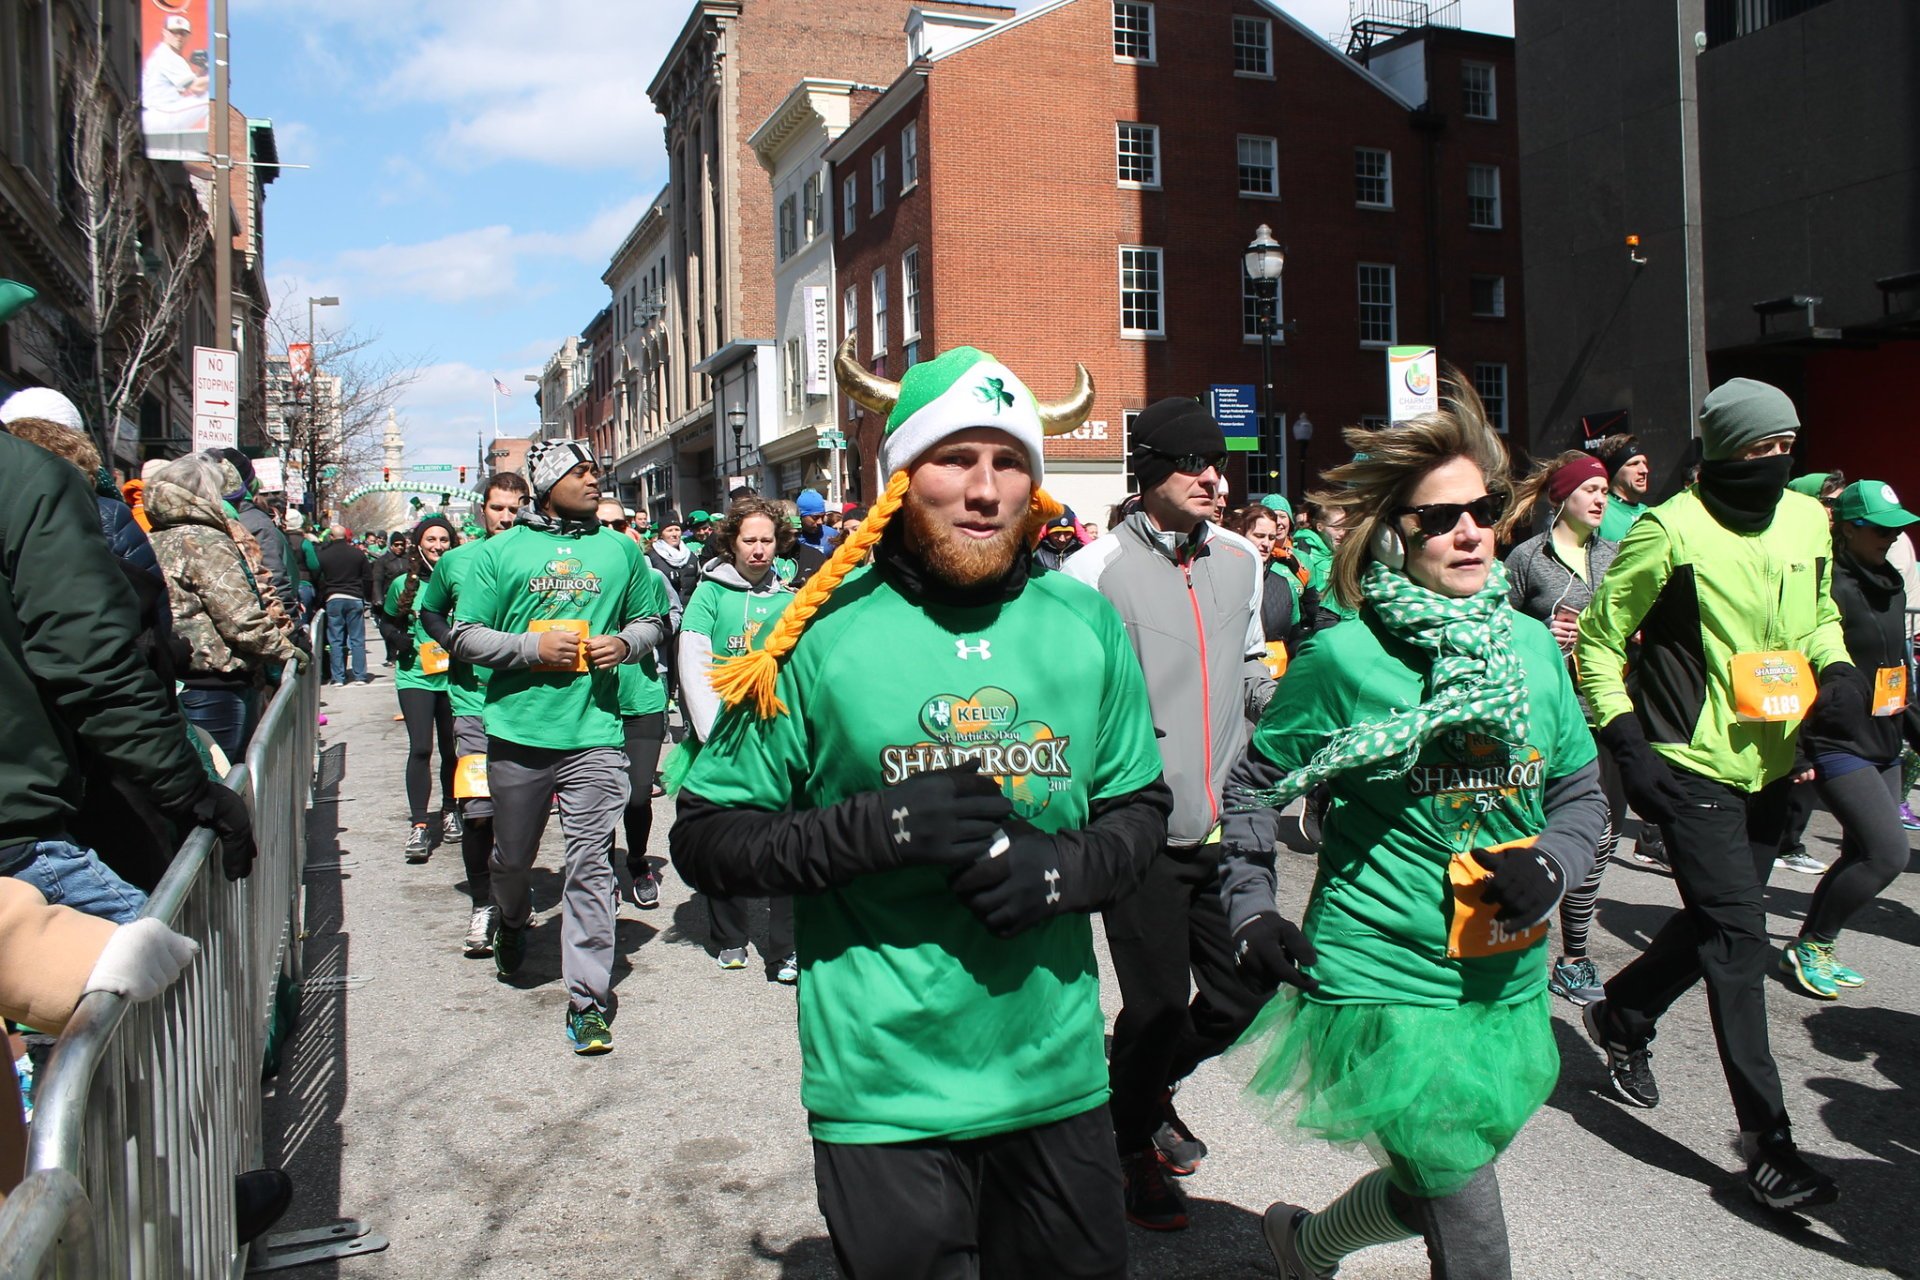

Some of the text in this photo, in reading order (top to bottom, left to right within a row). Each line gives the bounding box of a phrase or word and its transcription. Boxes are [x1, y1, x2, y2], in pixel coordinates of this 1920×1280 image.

[815, 298, 827, 381] BYTE RIGHT
[208, 357, 223, 371] NO
[198, 377, 234, 392] STOPPING
[208, 419, 222, 430] NO
[197, 430, 233, 443] PARKING
[530, 578, 601, 592] SHAMROCK
[556, 591, 571, 601] 5K
[1762, 694, 1799, 715] 4189
[957, 706, 1009, 722] KELLY
[939, 732, 953, 743] St.
[999, 729, 1020, 742] Day
[883, 738, 1071, 785] SHAMROCK
[1472, 793, 1504, 813] 5K
